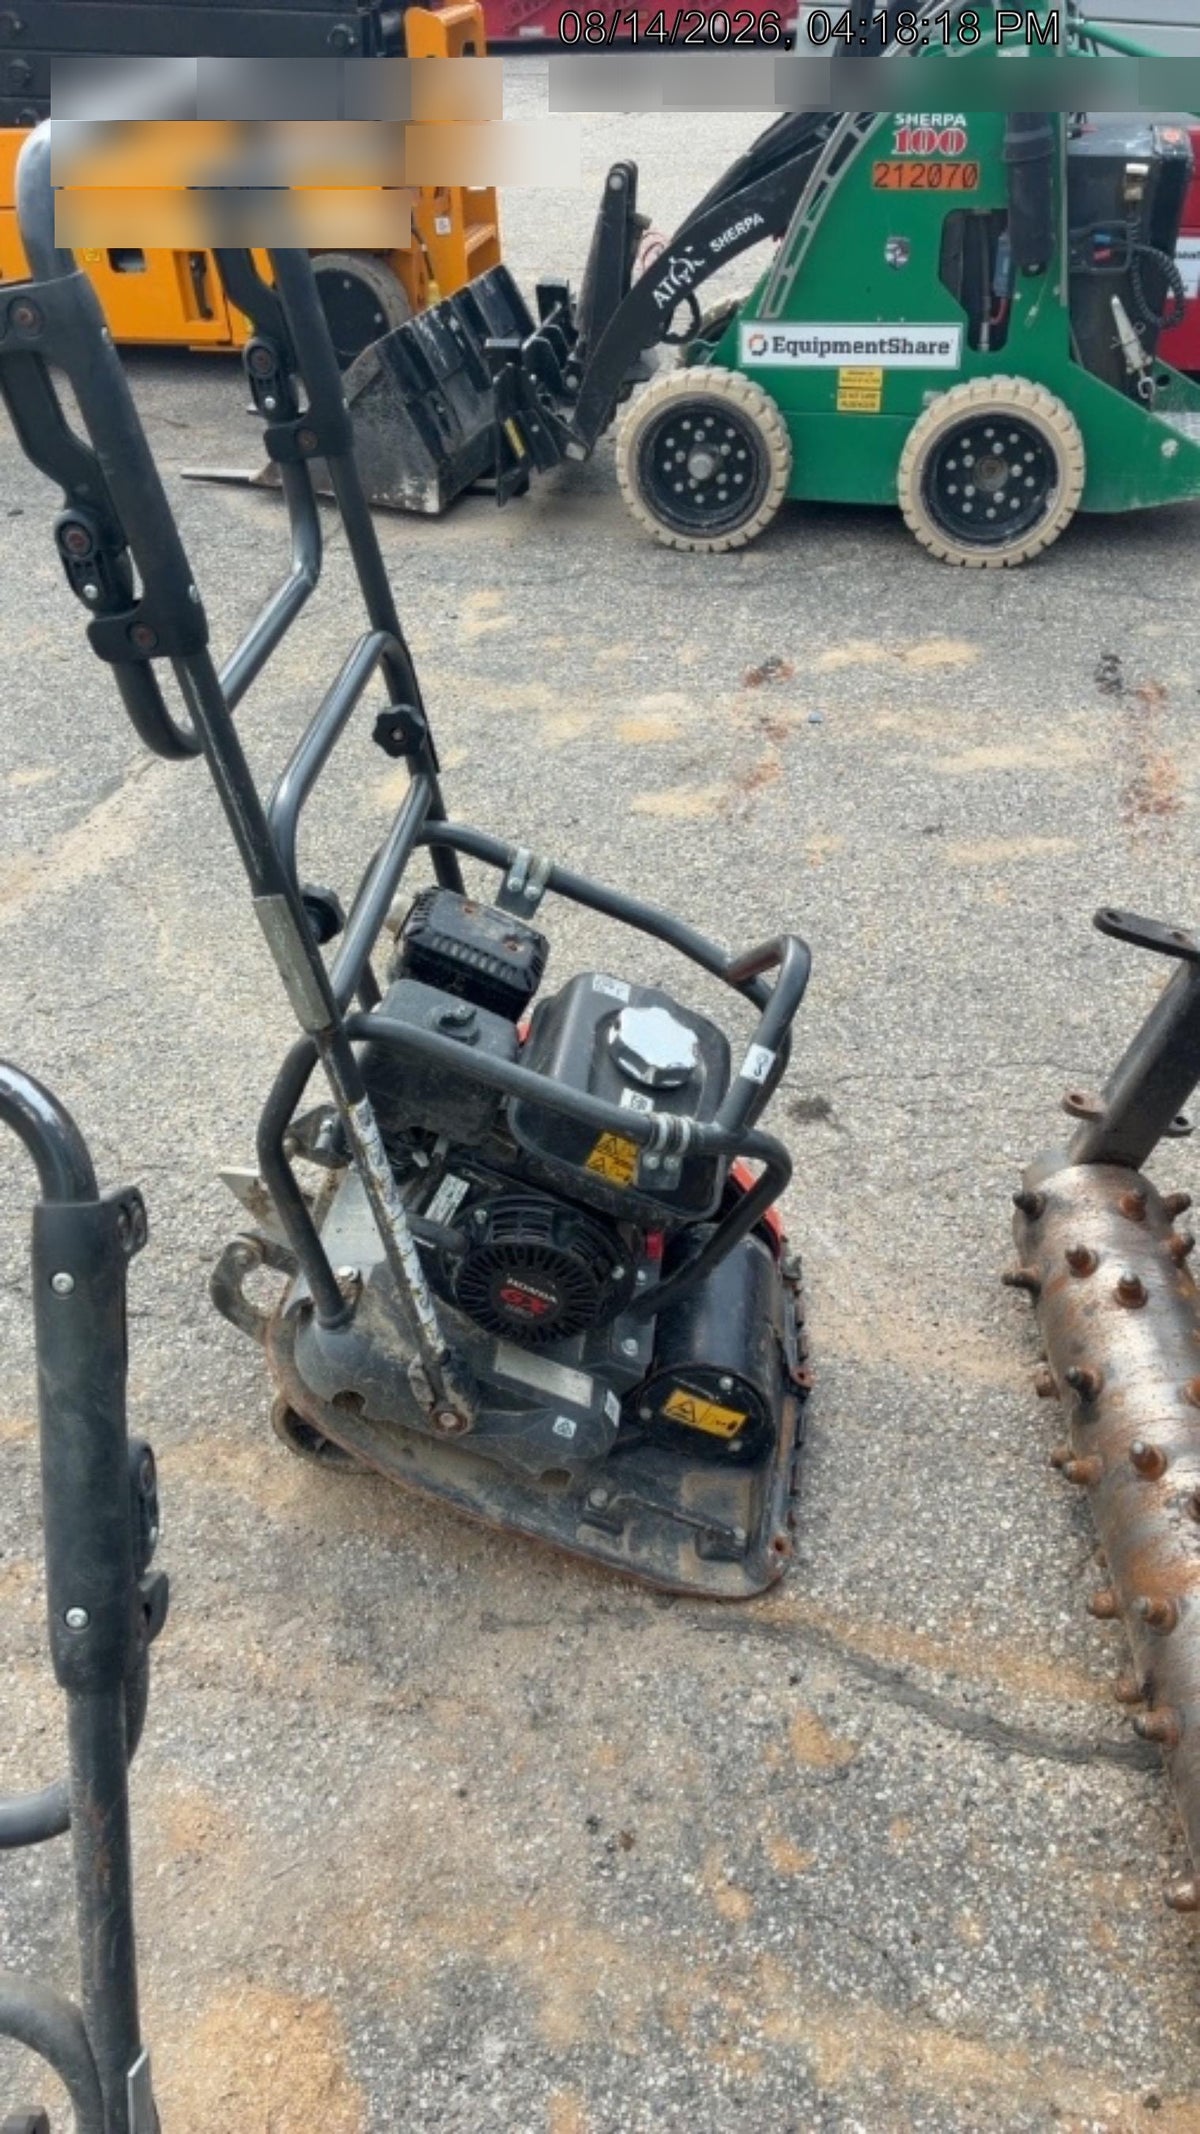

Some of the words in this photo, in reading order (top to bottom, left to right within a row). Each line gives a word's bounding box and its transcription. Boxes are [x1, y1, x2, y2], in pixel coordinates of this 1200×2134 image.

[893, 112, 968, 127] SHERPA
[891, 126, 968, 156] 100
[873, 162, 978, 189] 212070
[709, 212, 765, 253] SHERPA
[771, 335, 951, 359] EquipmentShare
